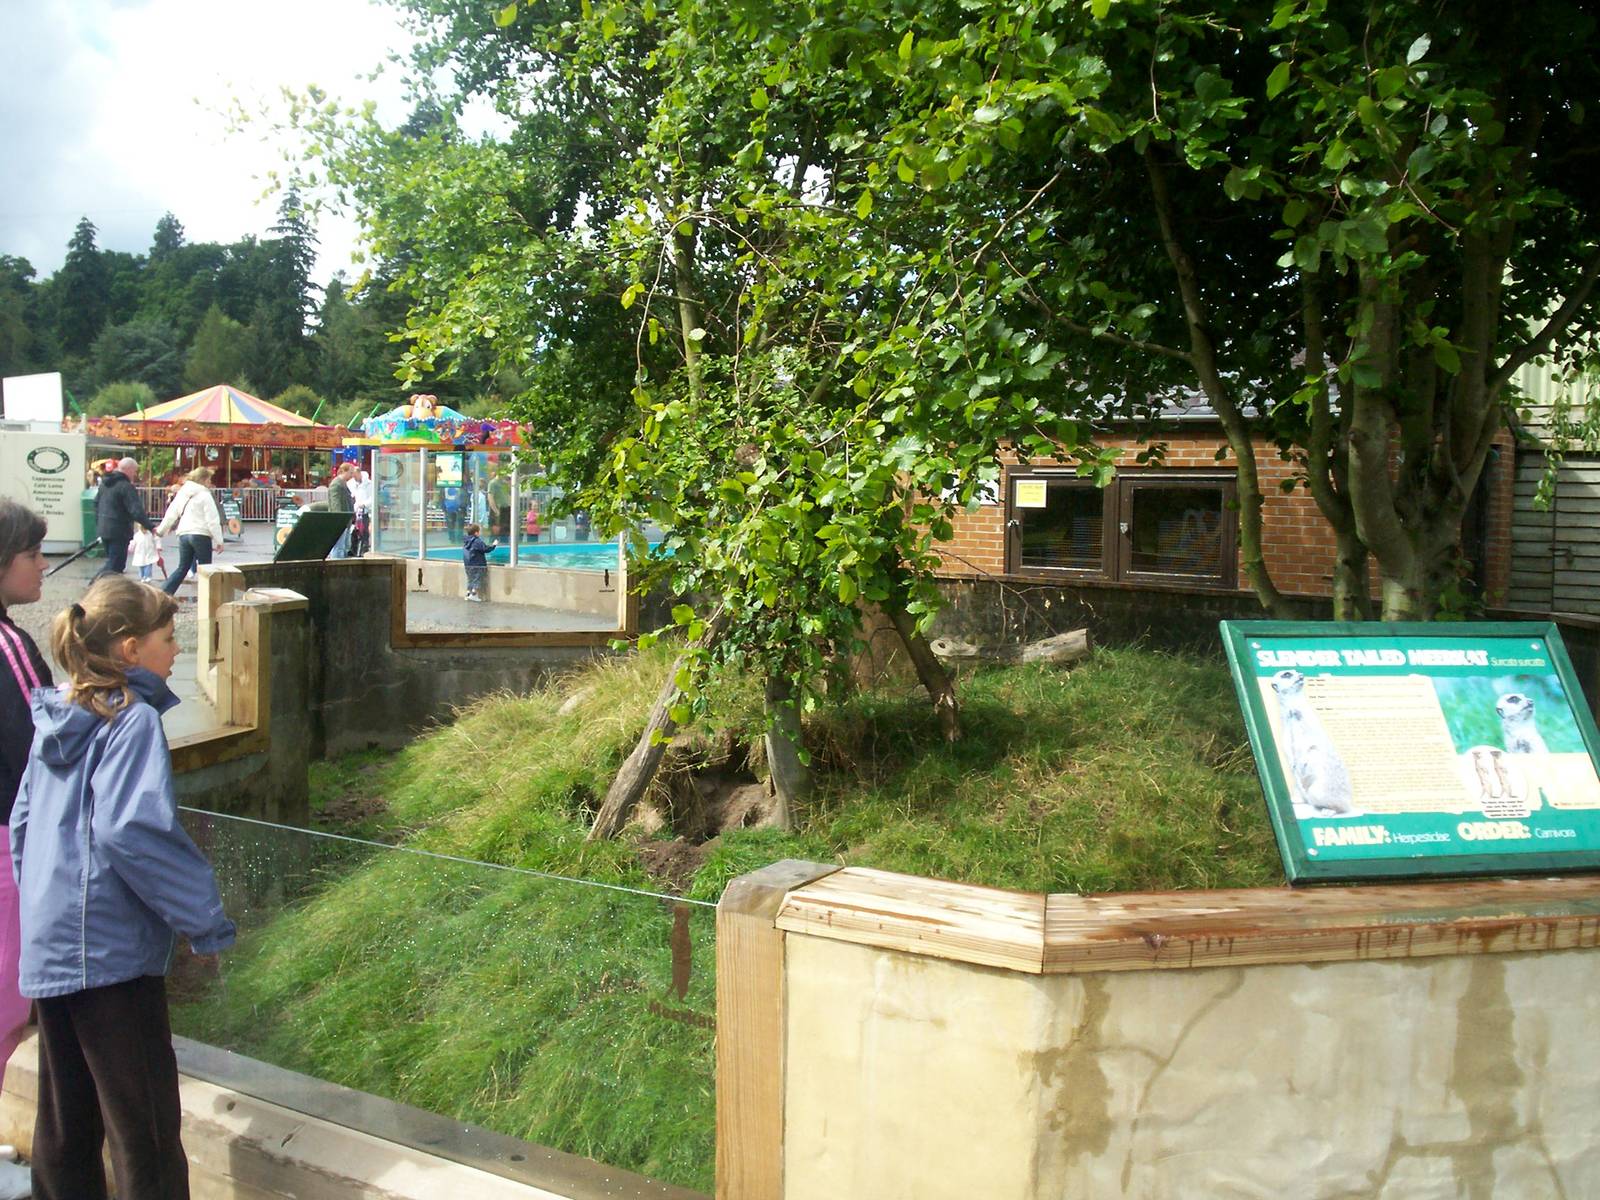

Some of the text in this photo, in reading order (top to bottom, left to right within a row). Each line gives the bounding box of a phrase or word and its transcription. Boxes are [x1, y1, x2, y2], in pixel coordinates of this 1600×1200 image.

[1256, 649, 1489, 667] SLENDER TAILED MEERKAT
[1311, 825, 1392, 846] FAMILY:
[1457, 821, 1532, 840] ORDER:
